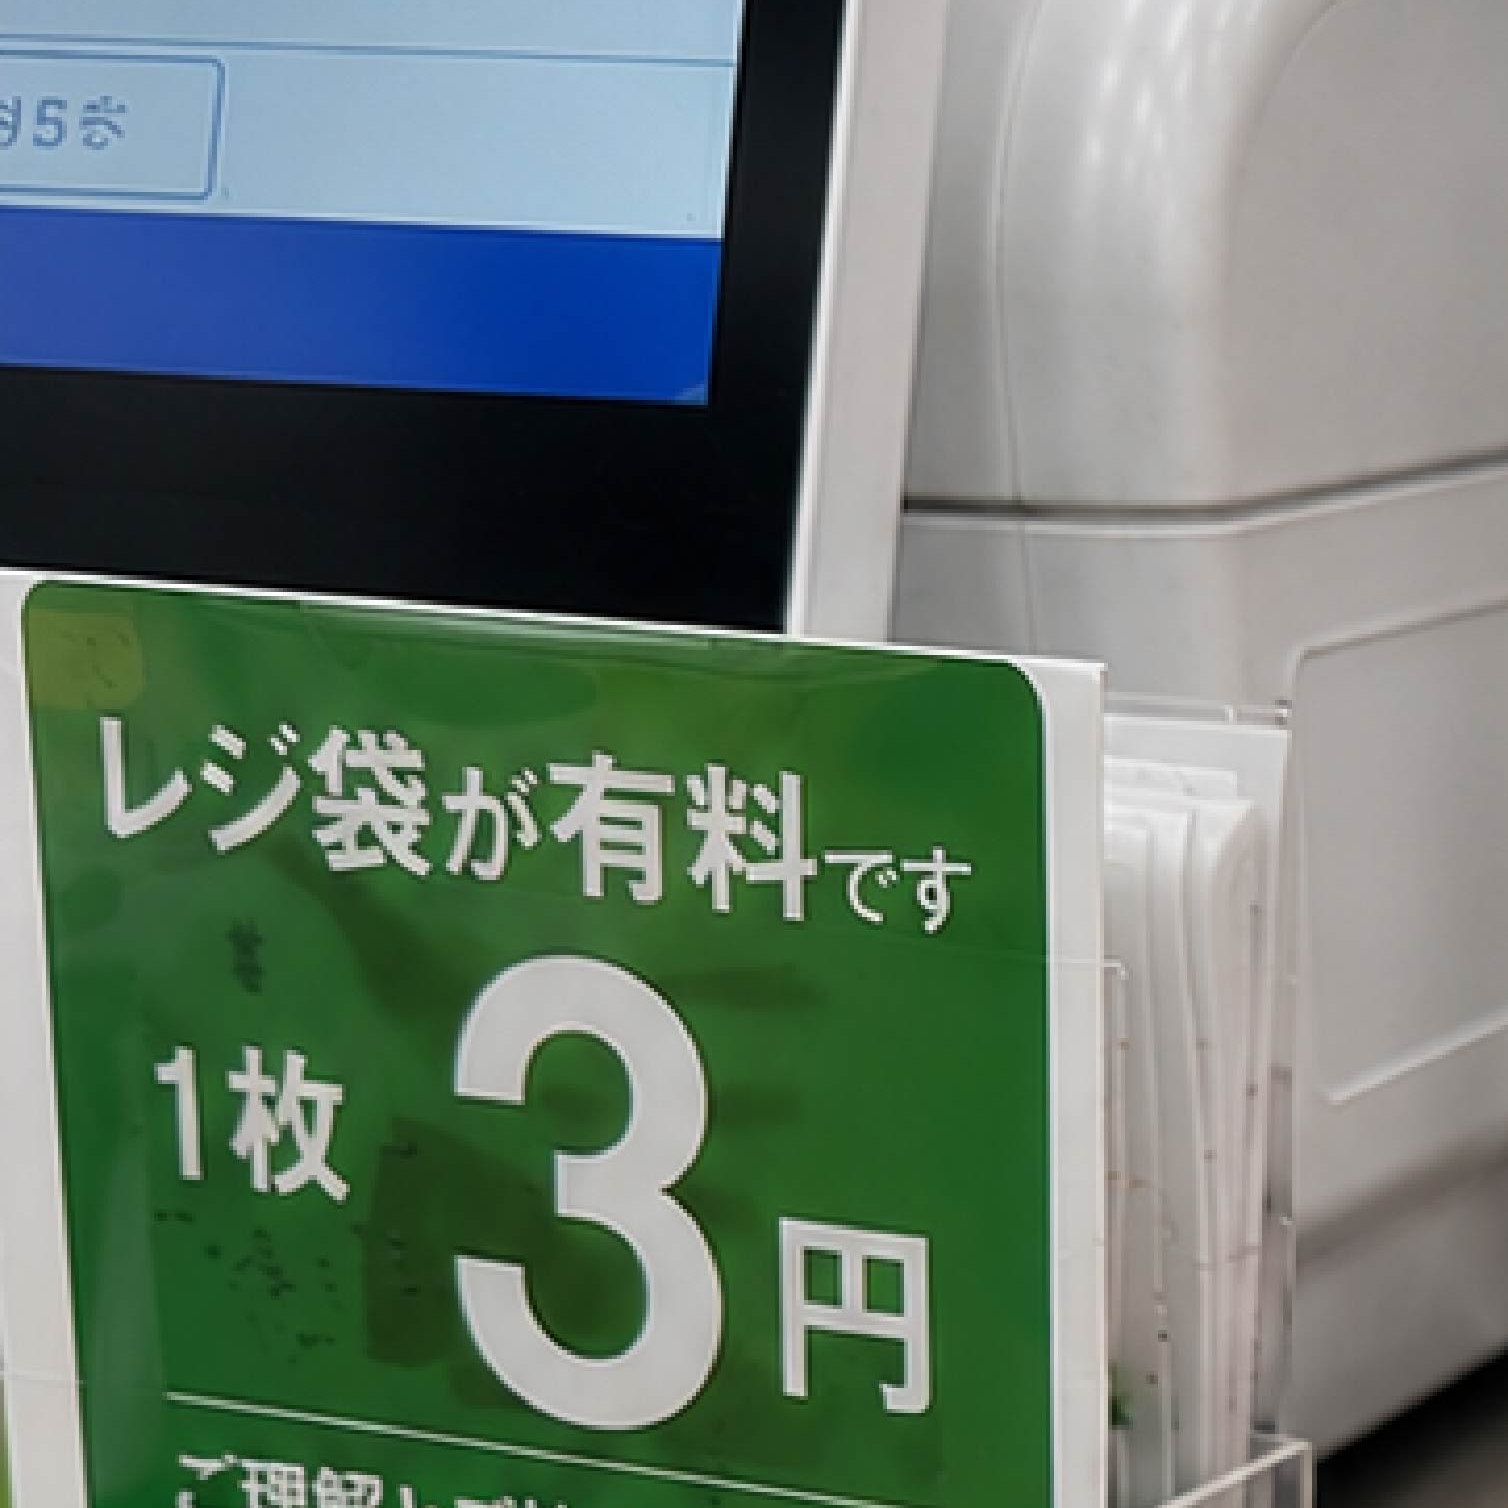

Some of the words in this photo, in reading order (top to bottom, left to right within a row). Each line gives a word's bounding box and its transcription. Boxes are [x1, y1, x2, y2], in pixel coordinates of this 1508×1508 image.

[98, 715, 971, 934] レジ袋が有料です
